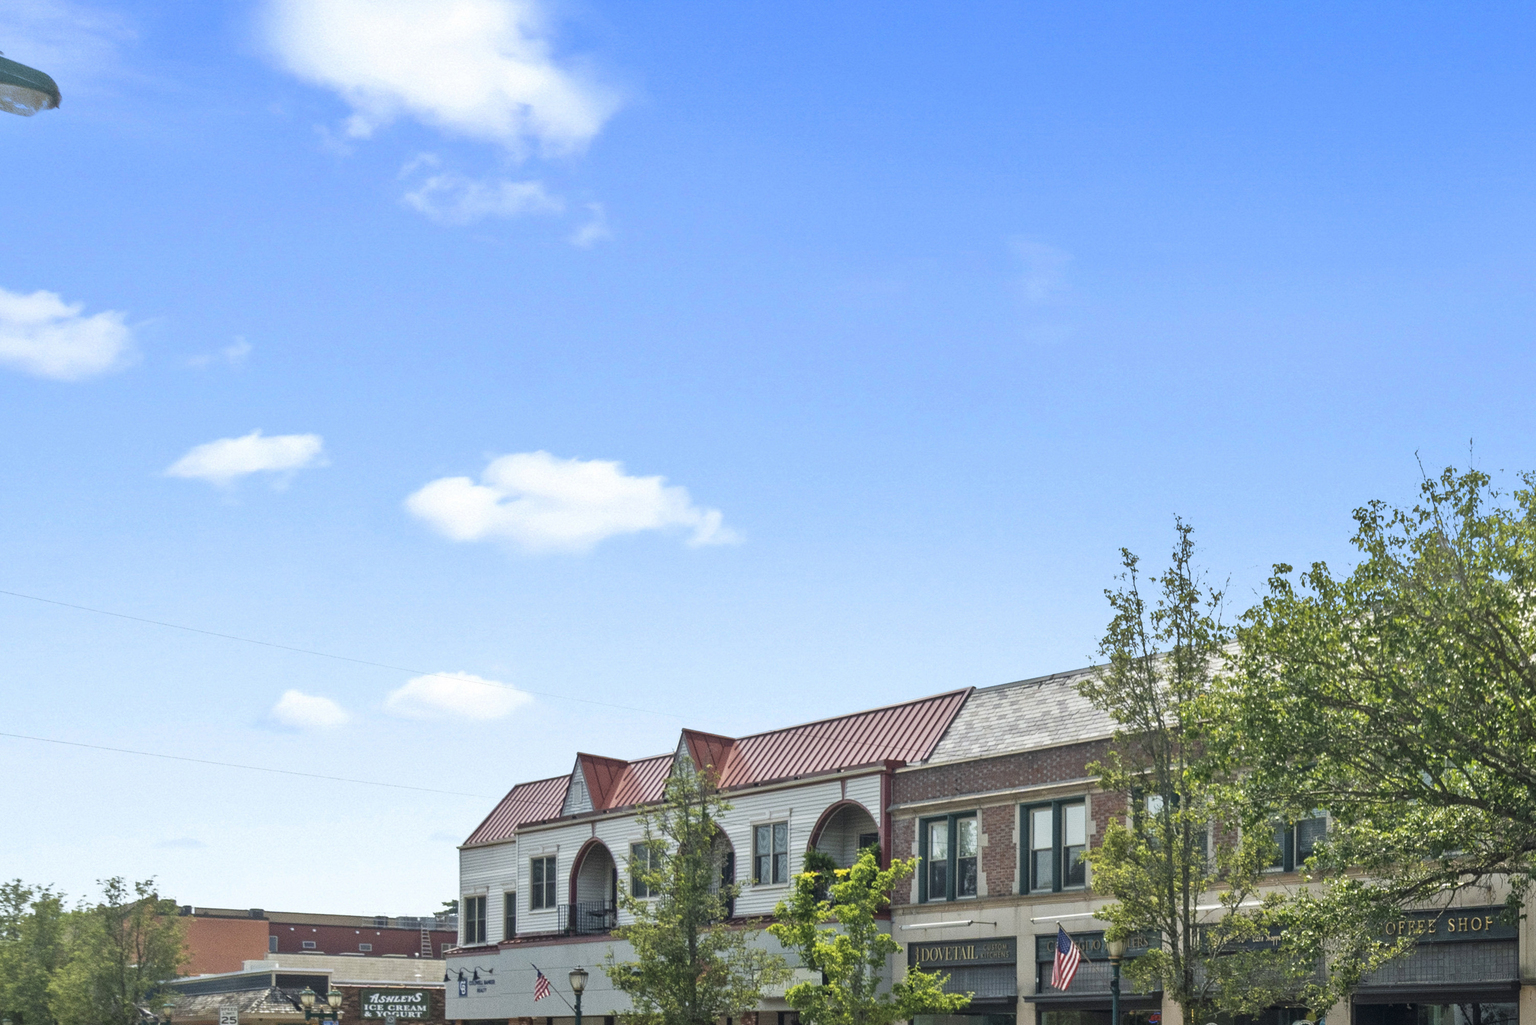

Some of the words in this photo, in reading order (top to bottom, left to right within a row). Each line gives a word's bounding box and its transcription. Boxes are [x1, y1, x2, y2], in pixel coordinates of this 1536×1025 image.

[1385, 918, 1436, 936] OFFEE
[982, 943, 1007, 951] CUSTOM
[921, 945, 978, 962] DOVETAIL
[980, 951, 1009, 959] KITCHENS
[221, 1016, 237, 1024] 25
